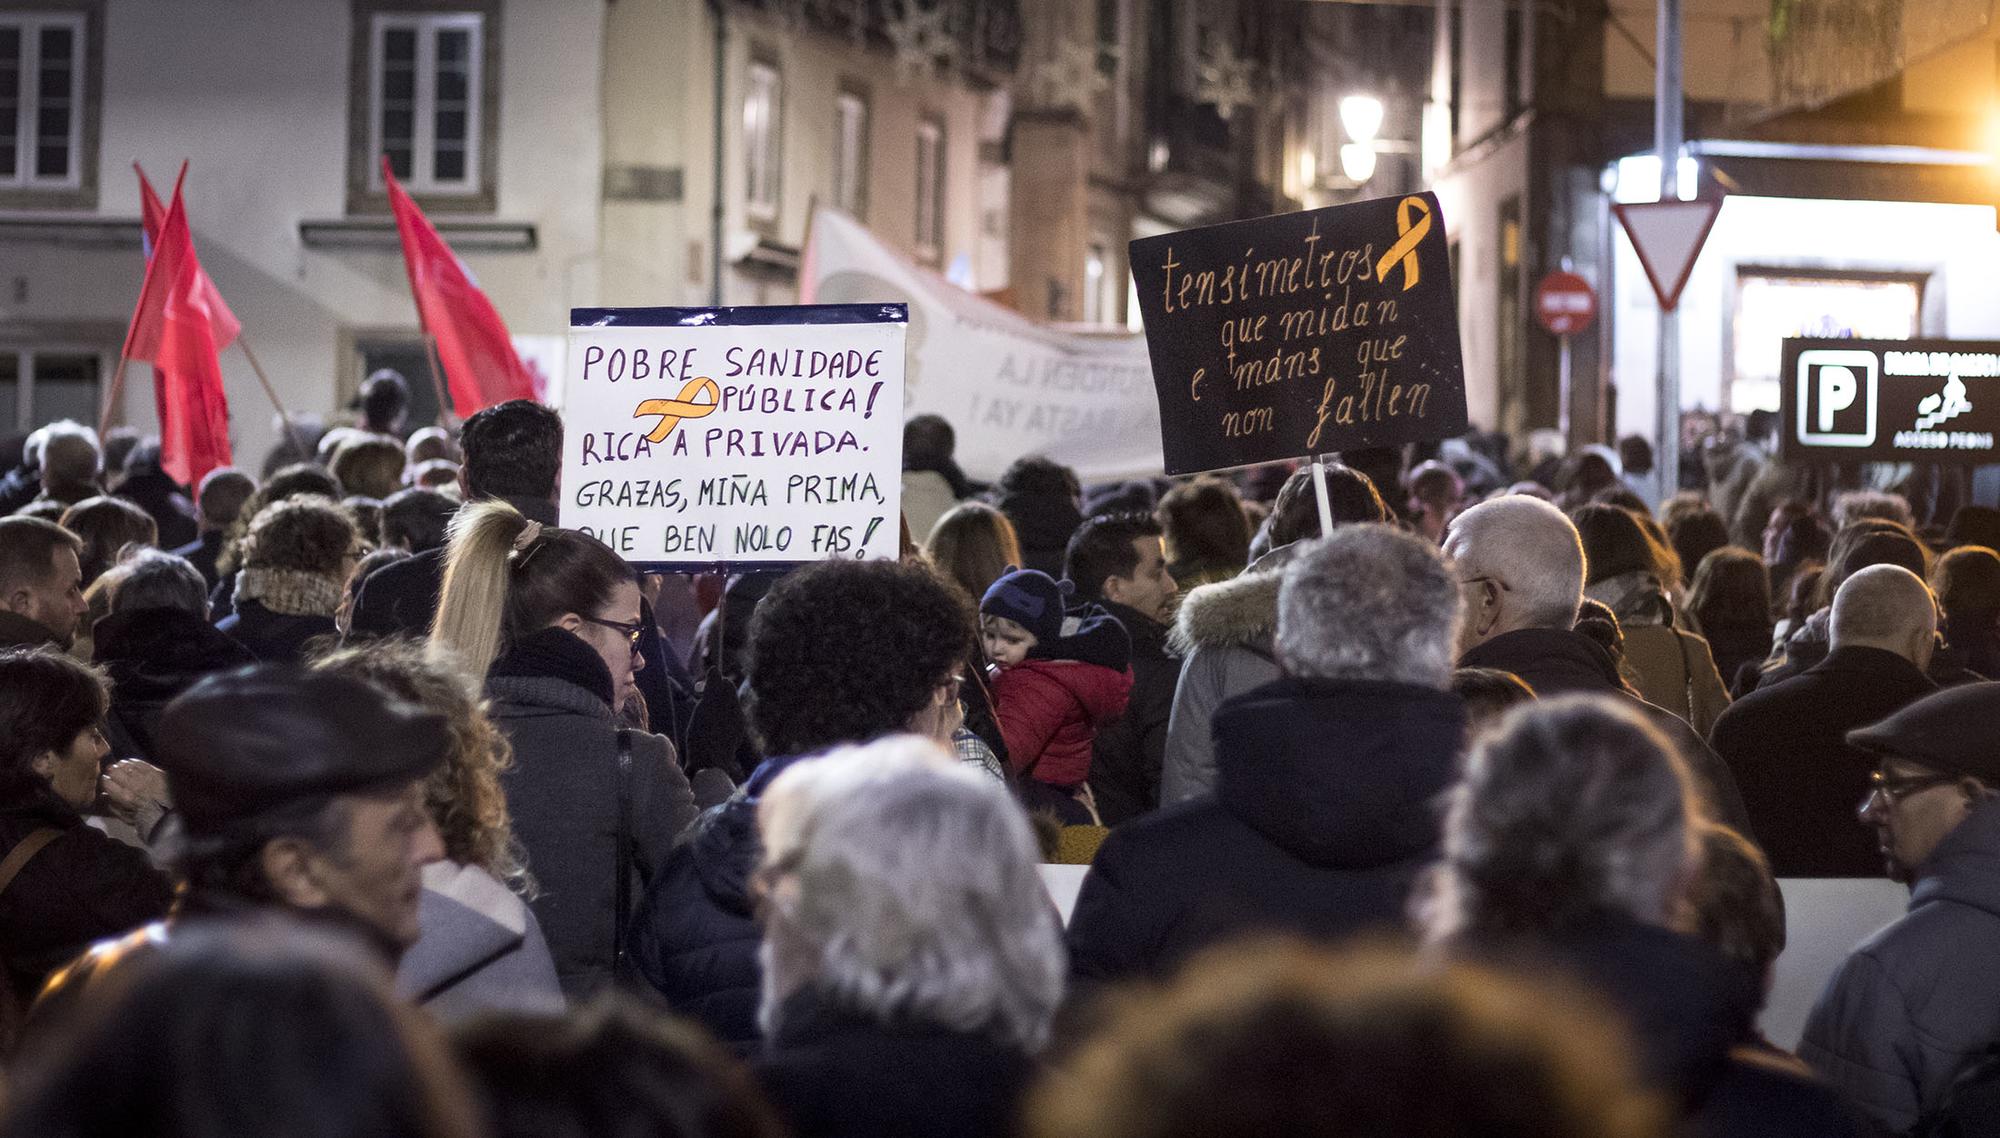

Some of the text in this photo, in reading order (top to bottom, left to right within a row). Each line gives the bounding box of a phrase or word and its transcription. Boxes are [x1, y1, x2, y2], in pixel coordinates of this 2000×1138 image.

[1161, 216, 1373, 314] tensímetros
[1221, 286, 1399, 375] que midan
[583, 346, 883, 382] POBRE SANIDADE
[1191, 367, 1206, 401] e
[1233, 347, 1321, 391] máns
[1357, 334, 1407, 389] que
[722, 381, 884, 420] PÚBLICA!
[1221, 368, 1431, 448] non fallen
[1818, 365, 1857, 432] P
[581, 428, 869, 466] RICA A PRIVADA.
[575, 472, 886, 513] GRAZAS, MIÑA PRIMA,
[664, 523, 716, 554] BEN
[735, 522, 792, 554] NOLO
[811, 517, 884, 560] FAS!
